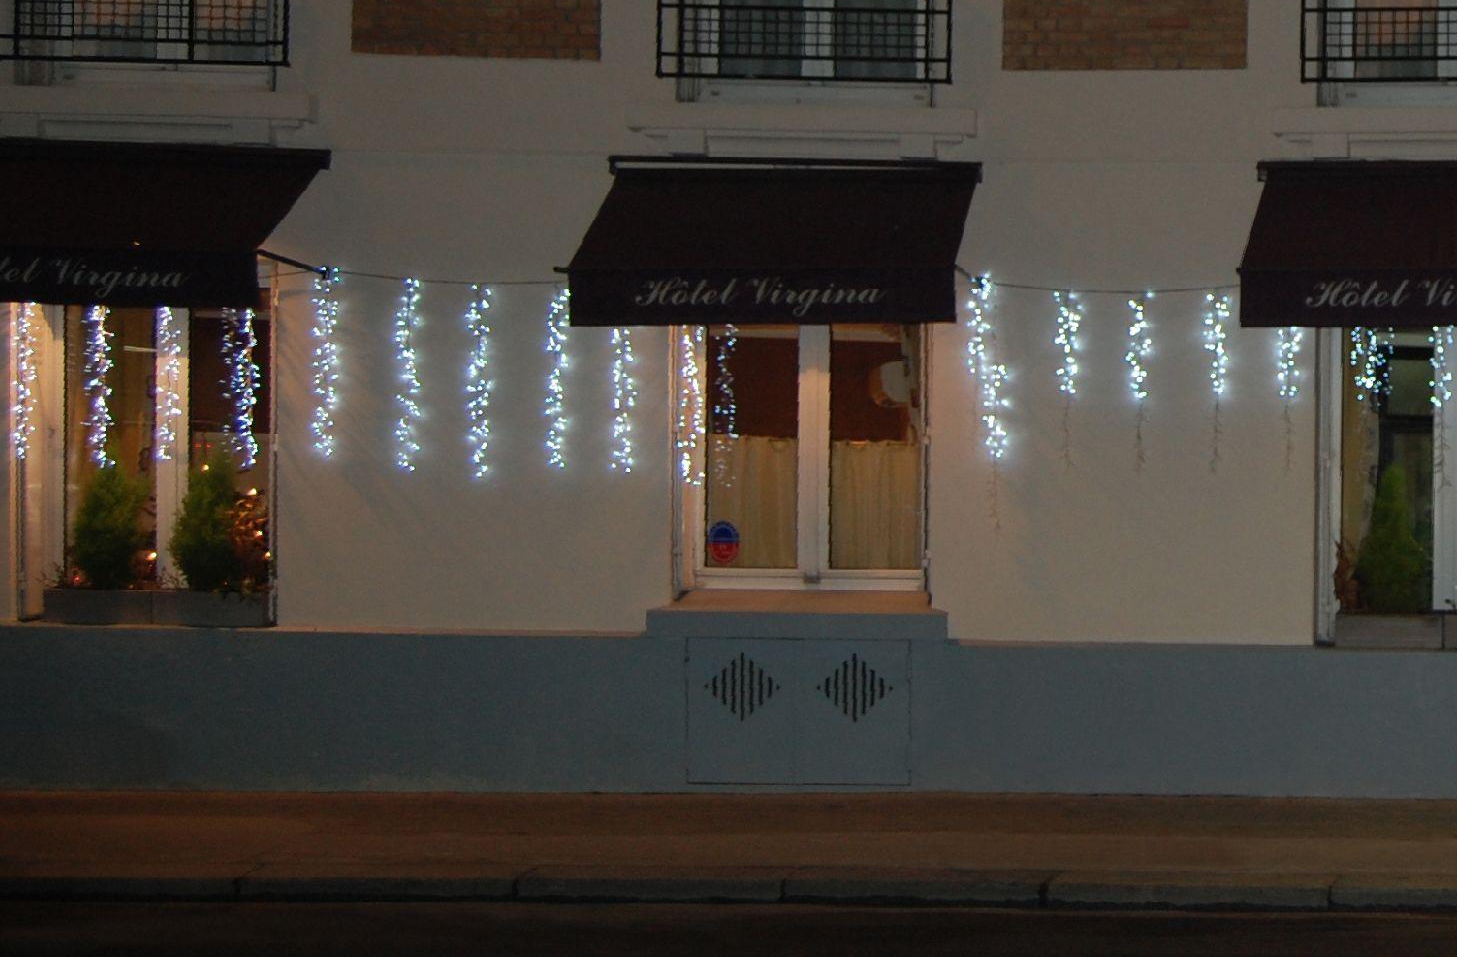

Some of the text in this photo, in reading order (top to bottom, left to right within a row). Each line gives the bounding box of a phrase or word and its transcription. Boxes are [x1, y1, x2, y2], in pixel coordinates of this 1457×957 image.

[50, 256, 189, 298] Virgina
[634, 275, 883, 317] Hôtel Virgina
[1304, 278, 1411, 309] Hôtel
